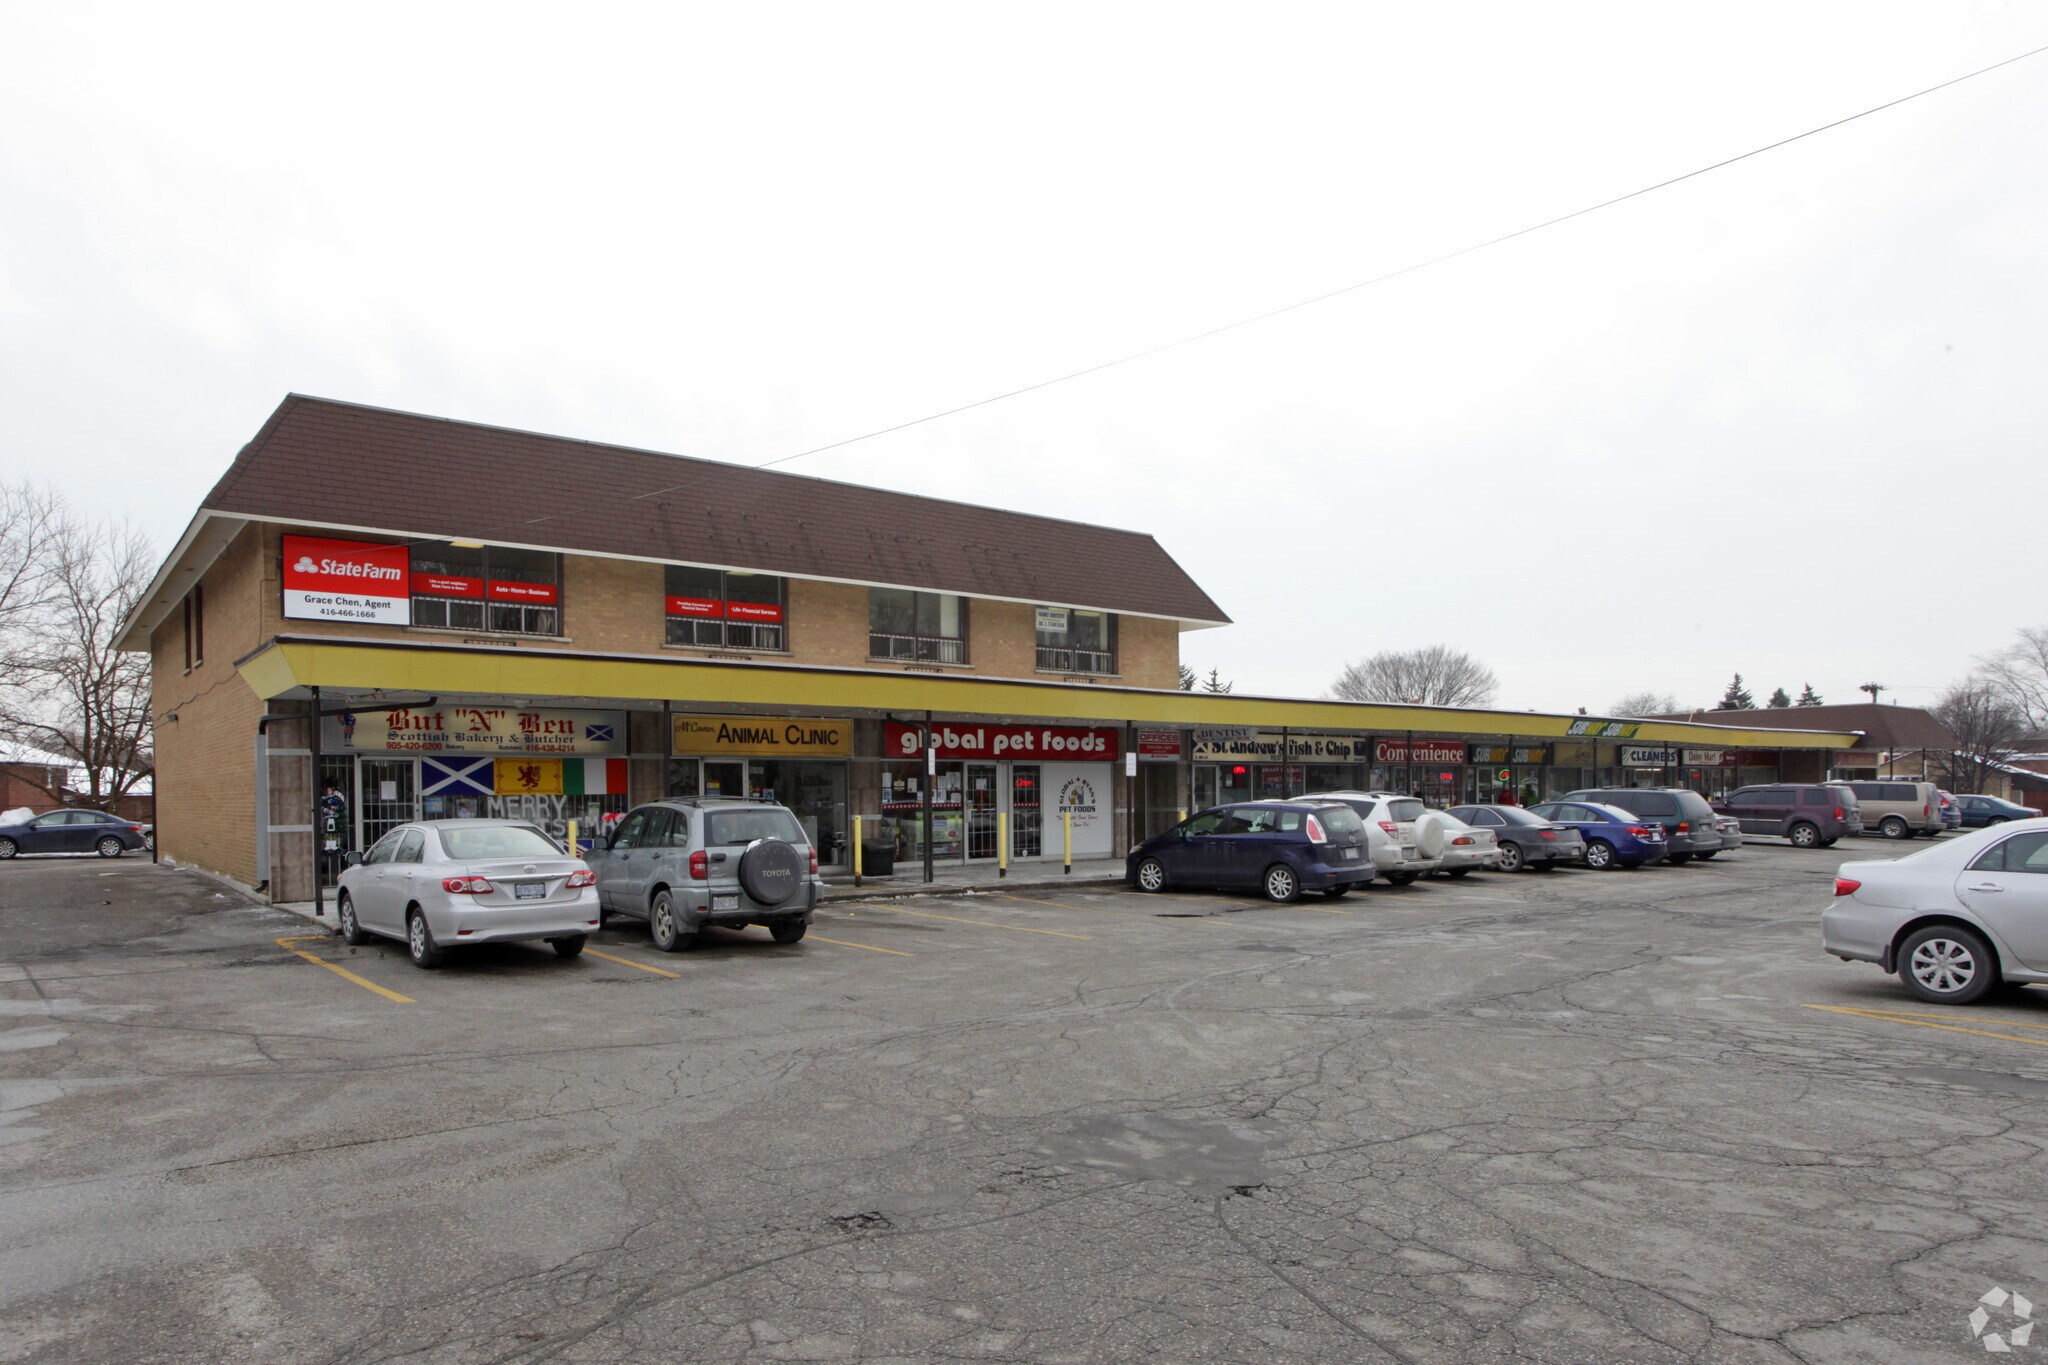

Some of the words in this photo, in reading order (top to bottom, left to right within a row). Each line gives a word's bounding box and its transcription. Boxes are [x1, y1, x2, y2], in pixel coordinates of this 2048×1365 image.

[304, 594, 332, 605] Grace
[335, 596, 362, 607] Chen,
[365, 599, 391, 610] Agent
[320, 608, 376, 618] 416-466-1666
[385, 709, 445, 731] But
[517, 713, 575, 735] Ben
[1568, 721, 1608, 735] SUBWAY
[1602, 723, 1639, 737] SUBWAY
[387, 731, 449, 742] Scottish
[454, 732, 504, 745] Bakery
[509, 734, 519, 743] &
[524, 734, 576, 744] Butcher
[716, 723, 779, 744] ANIMAL
[785, 725, 839, 745] CLINIC
[1140, 733, 1179, 742] OFFICES
[1201, 728, 1249, 738] DENTIST
[386, 742, 442, 751] 905-420-6200
[901, 728, 985, 754] global
[994, 731, 1034, 754] pet
[1042, 731, 1106, 752] foods
[1229, 740, 1285, 755] Andrew's
[1315, 741, 1324, 757] &
[1326, 740, 1350, 760] Chip
[1377, 743, 1464, 762] Convenience
[1473, 747, 1509, 763] SUBWAY
[1512, 748, 1547, 763] SUBWAY
[1631, 751, 1676, 763] CLEANERS
[487, 794, 566, 820] MERRY
[1074, 805, 1096, 813] FOODS
[762, 869, 791, 877] TOYOTA
